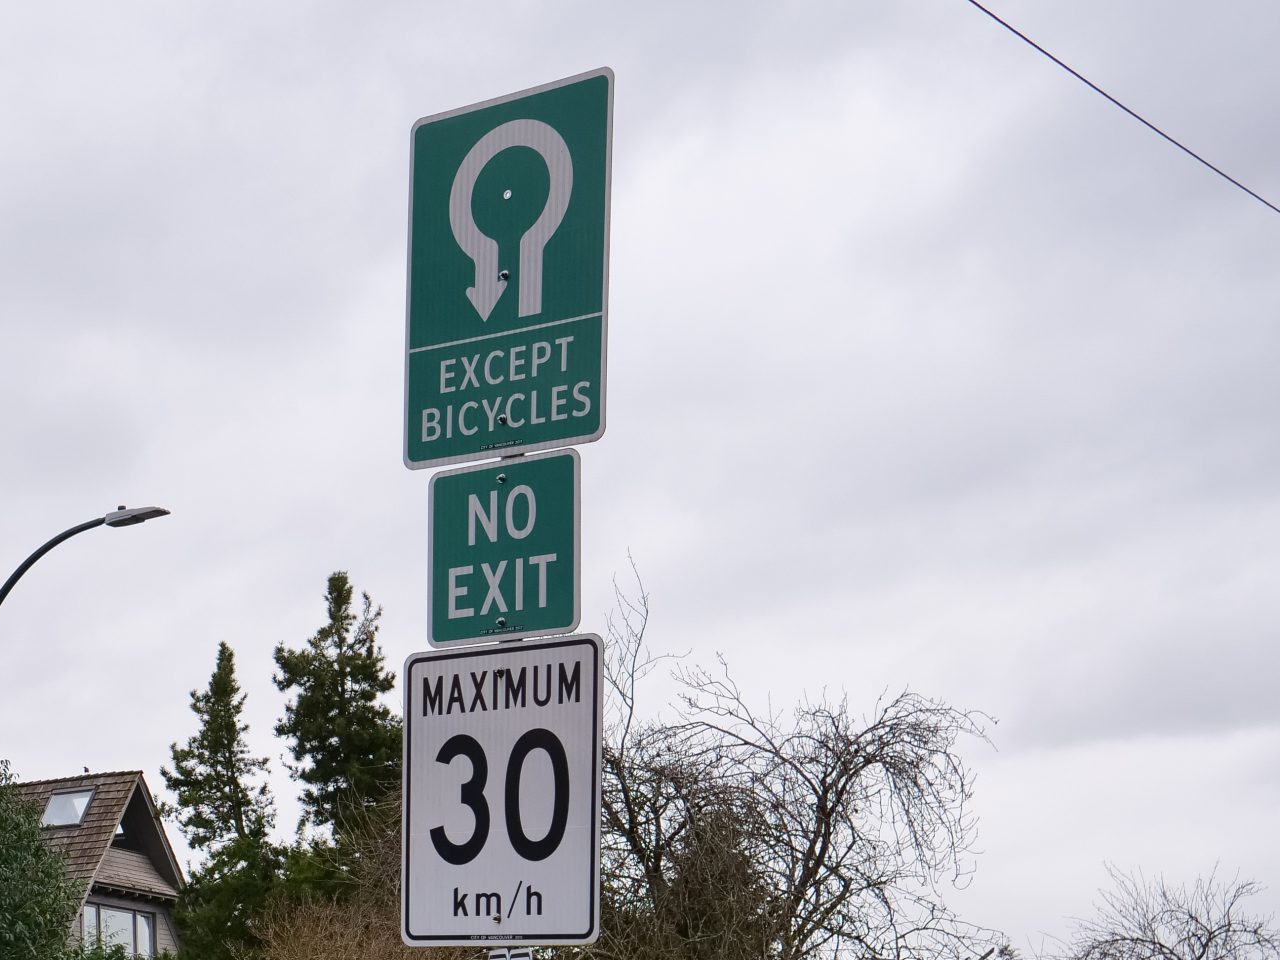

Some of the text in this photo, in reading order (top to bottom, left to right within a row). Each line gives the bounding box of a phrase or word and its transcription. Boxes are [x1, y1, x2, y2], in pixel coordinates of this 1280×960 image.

[440, 336, 574, 394] EXCEPT
[422, 381, 591, 442] BICYCLES
[468, 485, 537, 546] NO
[448, 553, 557, 619] EXIT
[423, 661, 581, 717] MAXIMUM
[429, 728, 570, 865] 30
[453, 881, 542, 919] km/h
